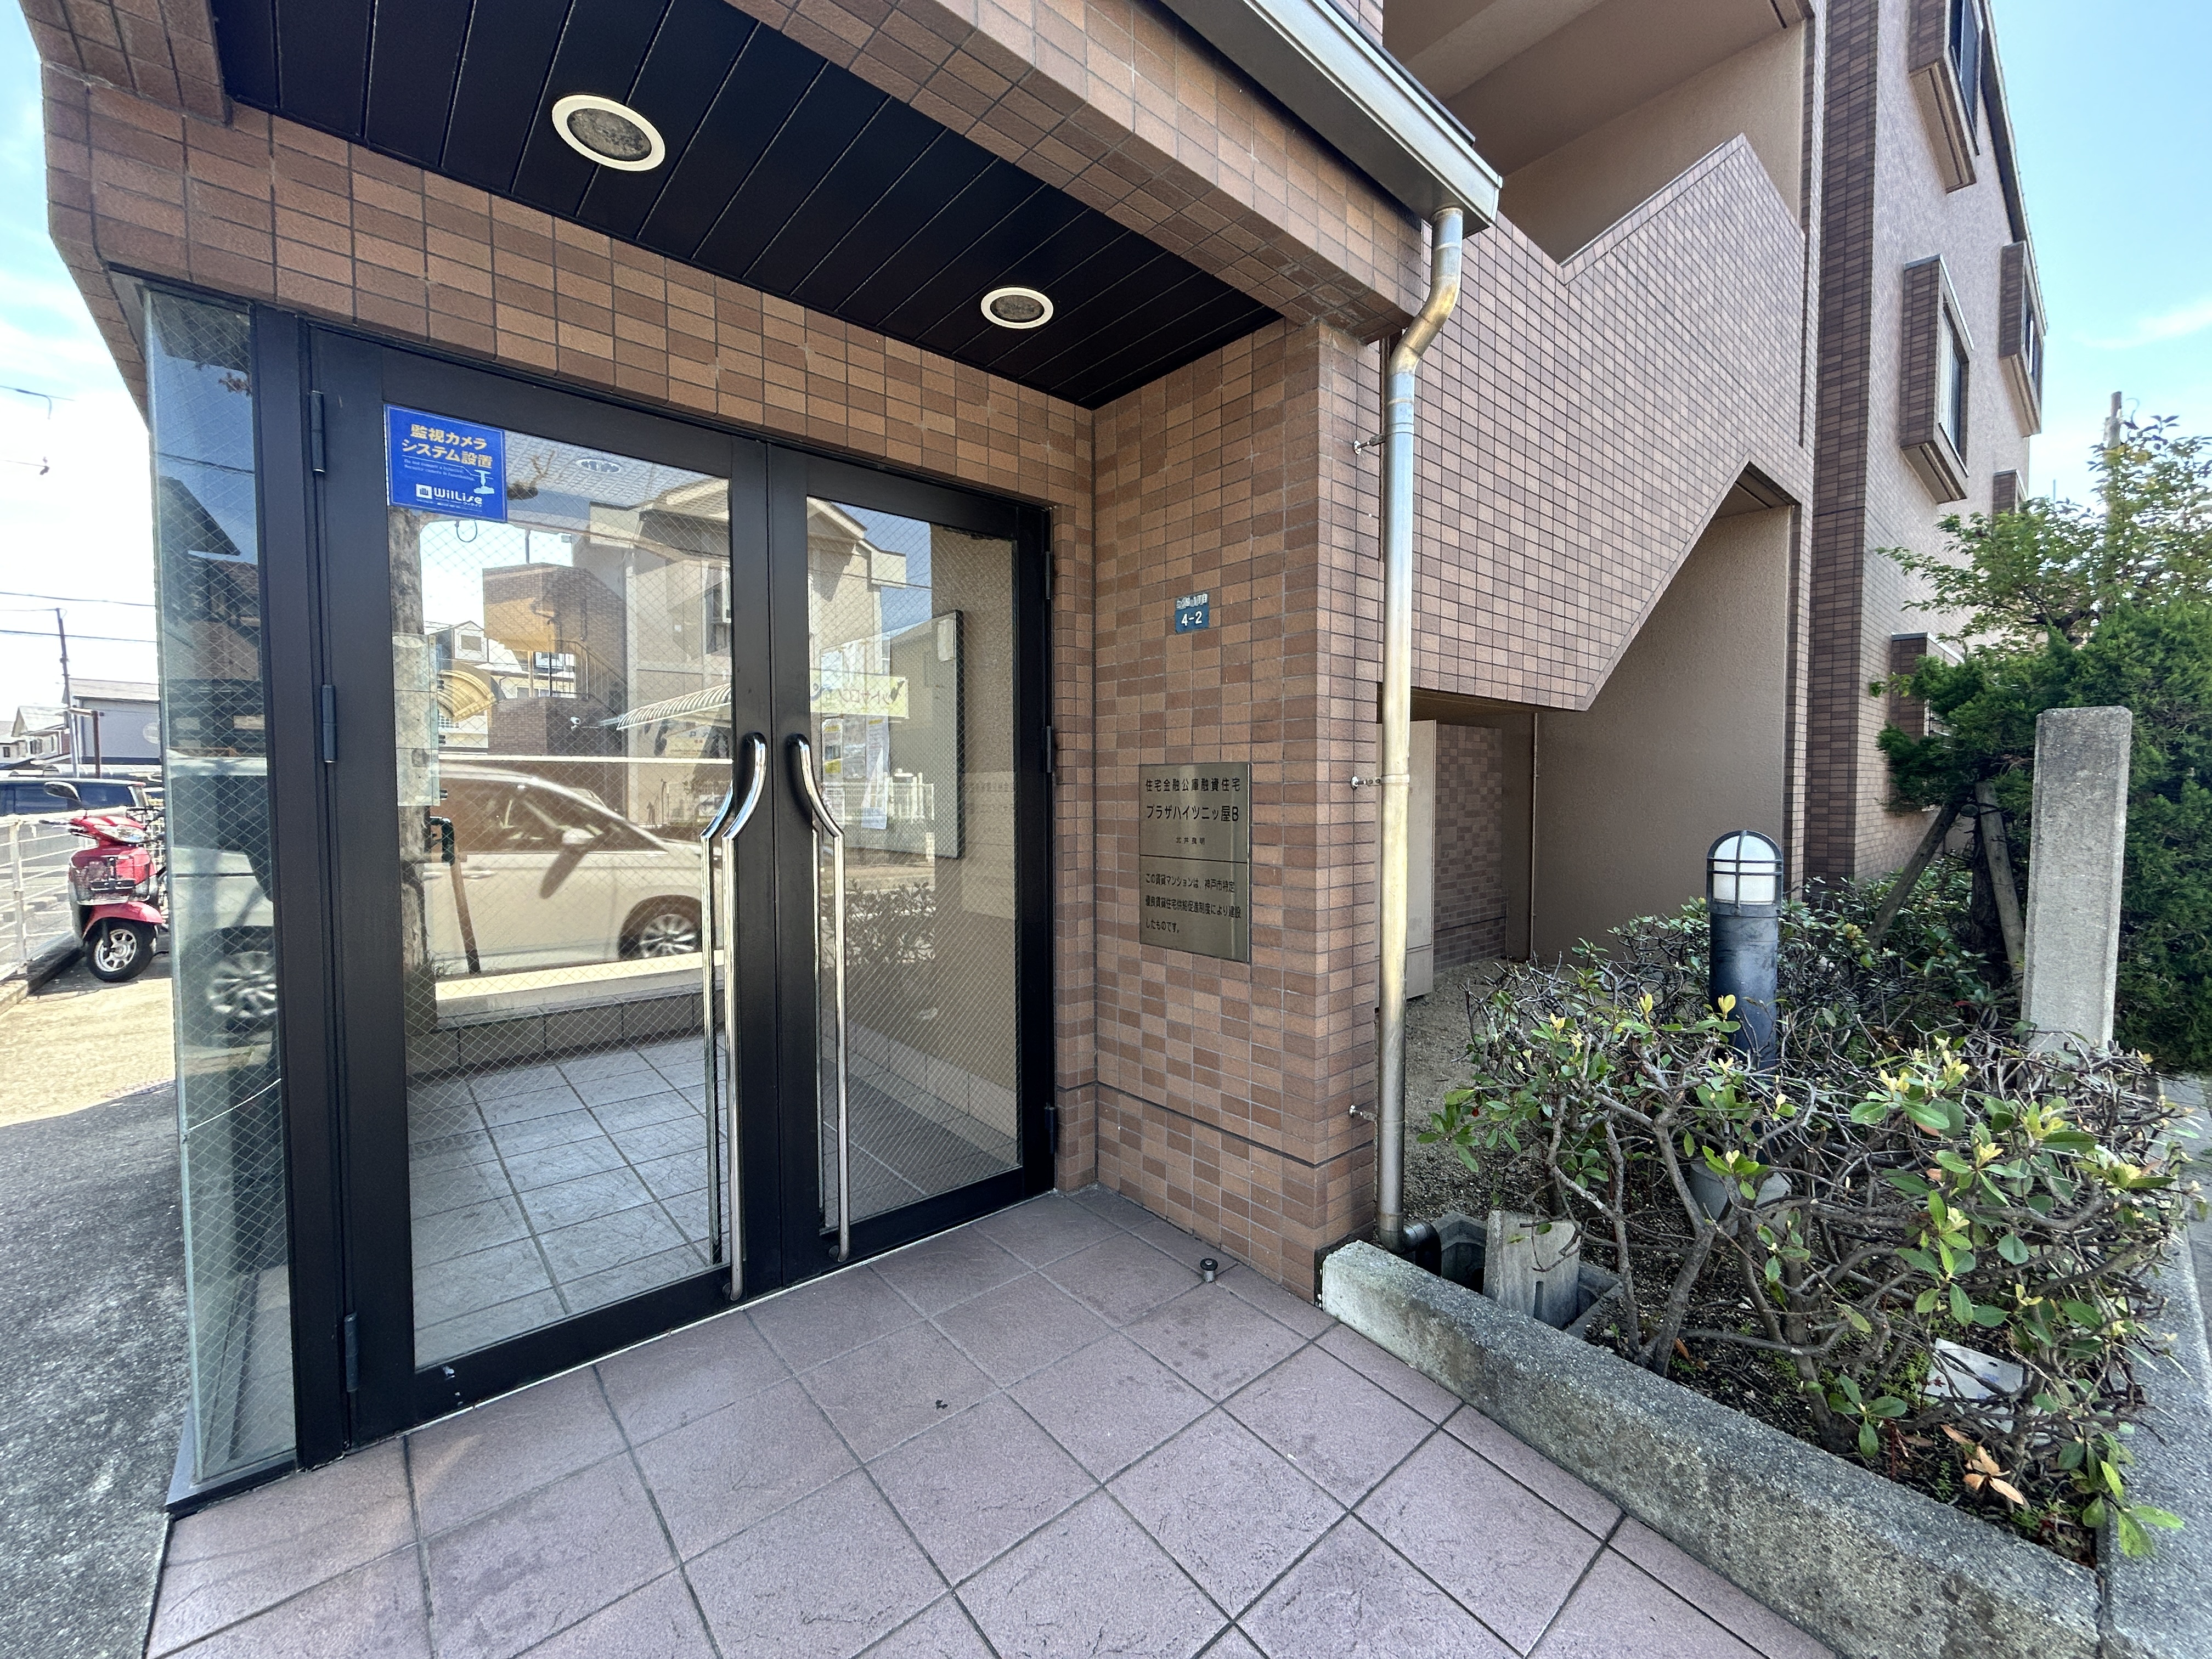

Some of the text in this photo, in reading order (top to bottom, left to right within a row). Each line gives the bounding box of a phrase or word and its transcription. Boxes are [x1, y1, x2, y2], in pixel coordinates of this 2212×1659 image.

[410, 424, 487, 450] 監視カメラ
[402, 439, 493, 469] システム設置
[1181, 610, 1203, 627] 4-2
[1146, 777, 1240, 792] 住宅金融公庫融資住宅
